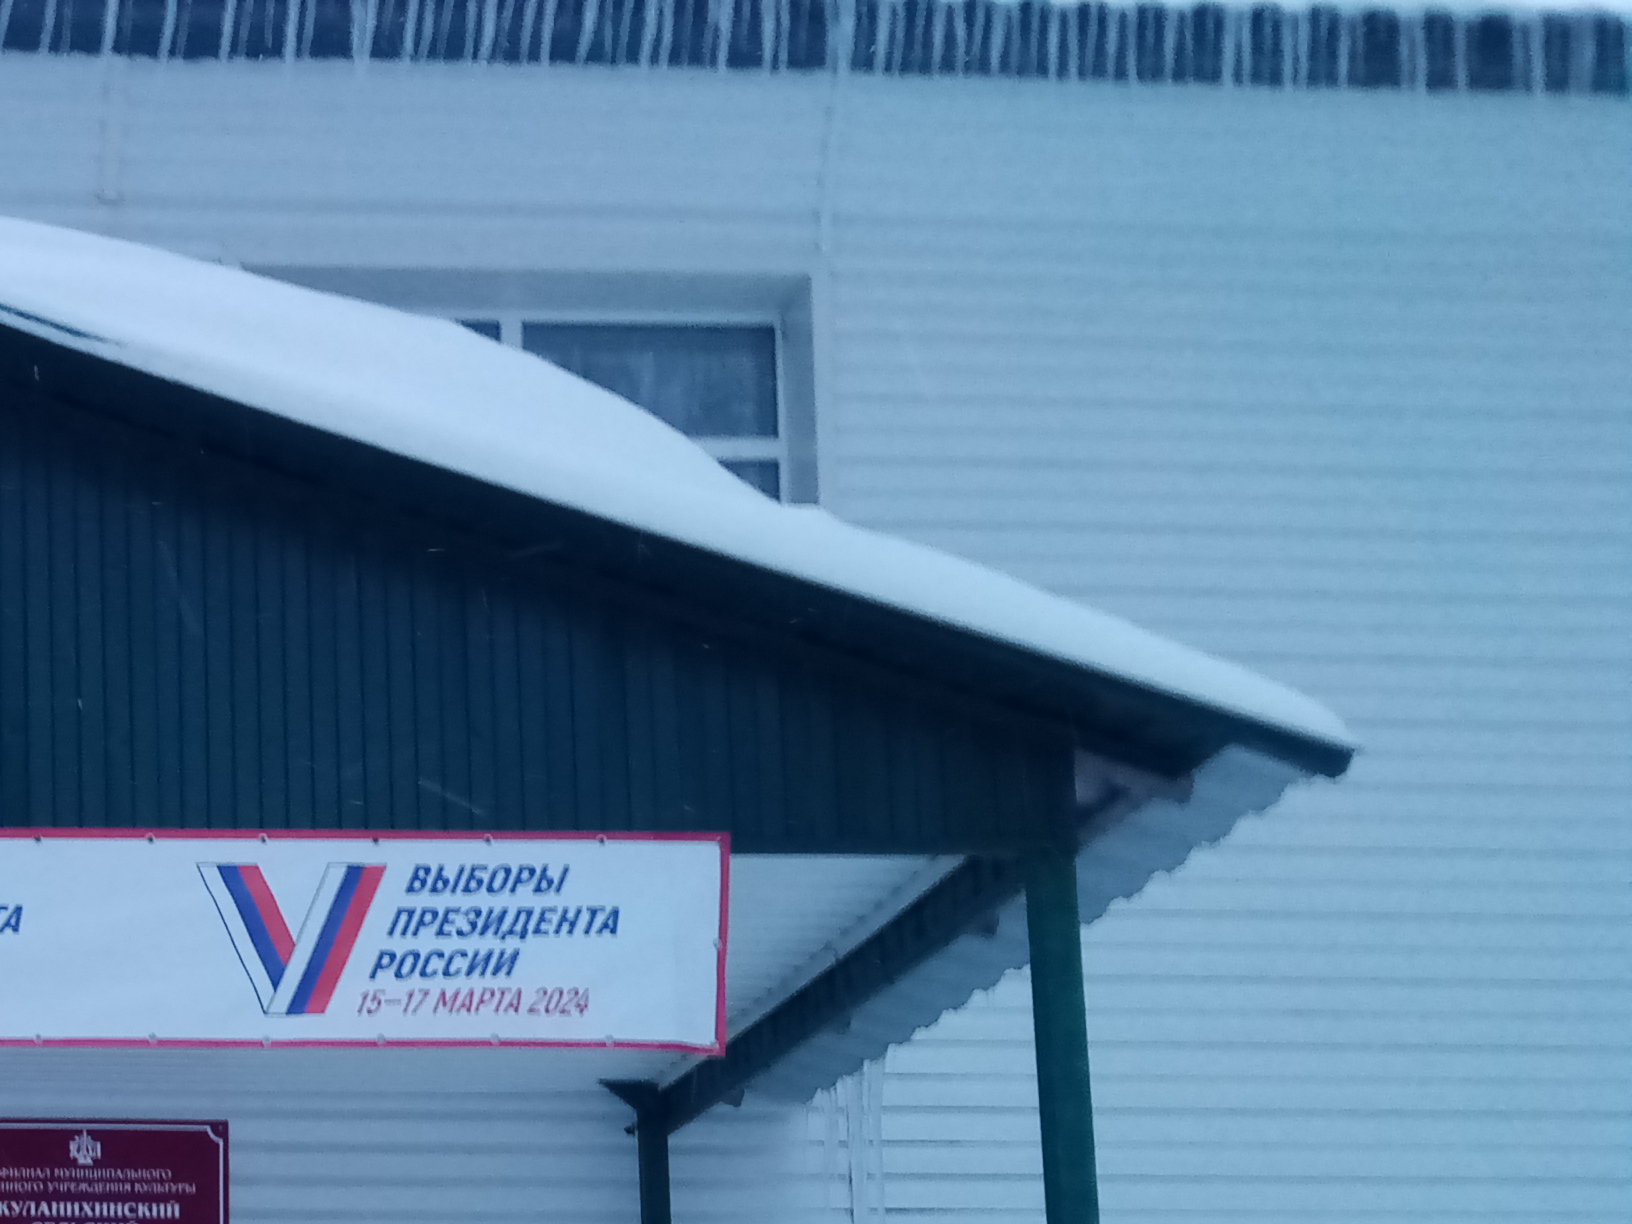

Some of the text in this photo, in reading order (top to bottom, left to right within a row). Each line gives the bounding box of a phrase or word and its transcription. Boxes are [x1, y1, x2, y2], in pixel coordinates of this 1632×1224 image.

[404, 863, 570, 895] ВЫБОРЫ
[386, 905, 620, 940] ПРЕЗИДЕНТА
[368, 948, 521, 981] РОССИИ
[434, 987, 522, 1017] МАРТА
[527, 988, 590, 1017] 2024
[0, 1167, 172, 1181] ФИЛИАЛ МУНИЦИПАЛЬНОГО
[47, 1181, 131, 1194] УЧРЕЖДЕНИЯ
[134, 1181, 196, 1194] КУЛЬТУРЫ
